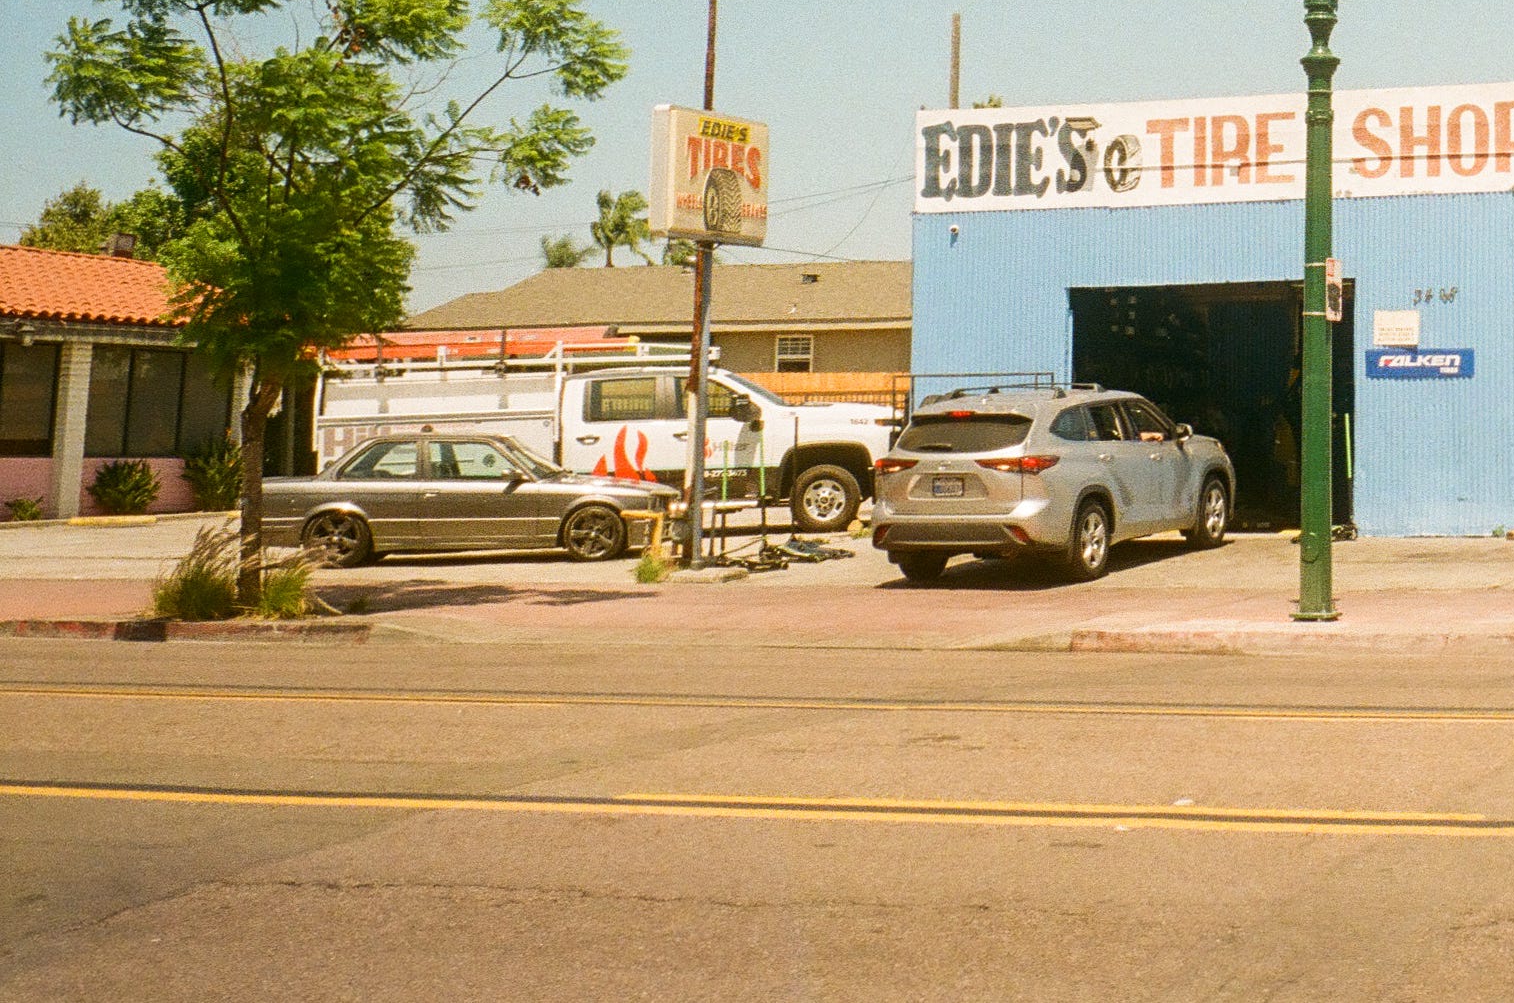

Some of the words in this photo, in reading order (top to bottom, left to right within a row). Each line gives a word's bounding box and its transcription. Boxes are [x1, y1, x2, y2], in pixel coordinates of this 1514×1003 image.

[687, 136, 761, 190] TIRES
[921, 116, 1088, 202] EDIE'S
[1146, 111, 1297, 189] TIRE
[1378, 354, 1461, 368] FALKEN
